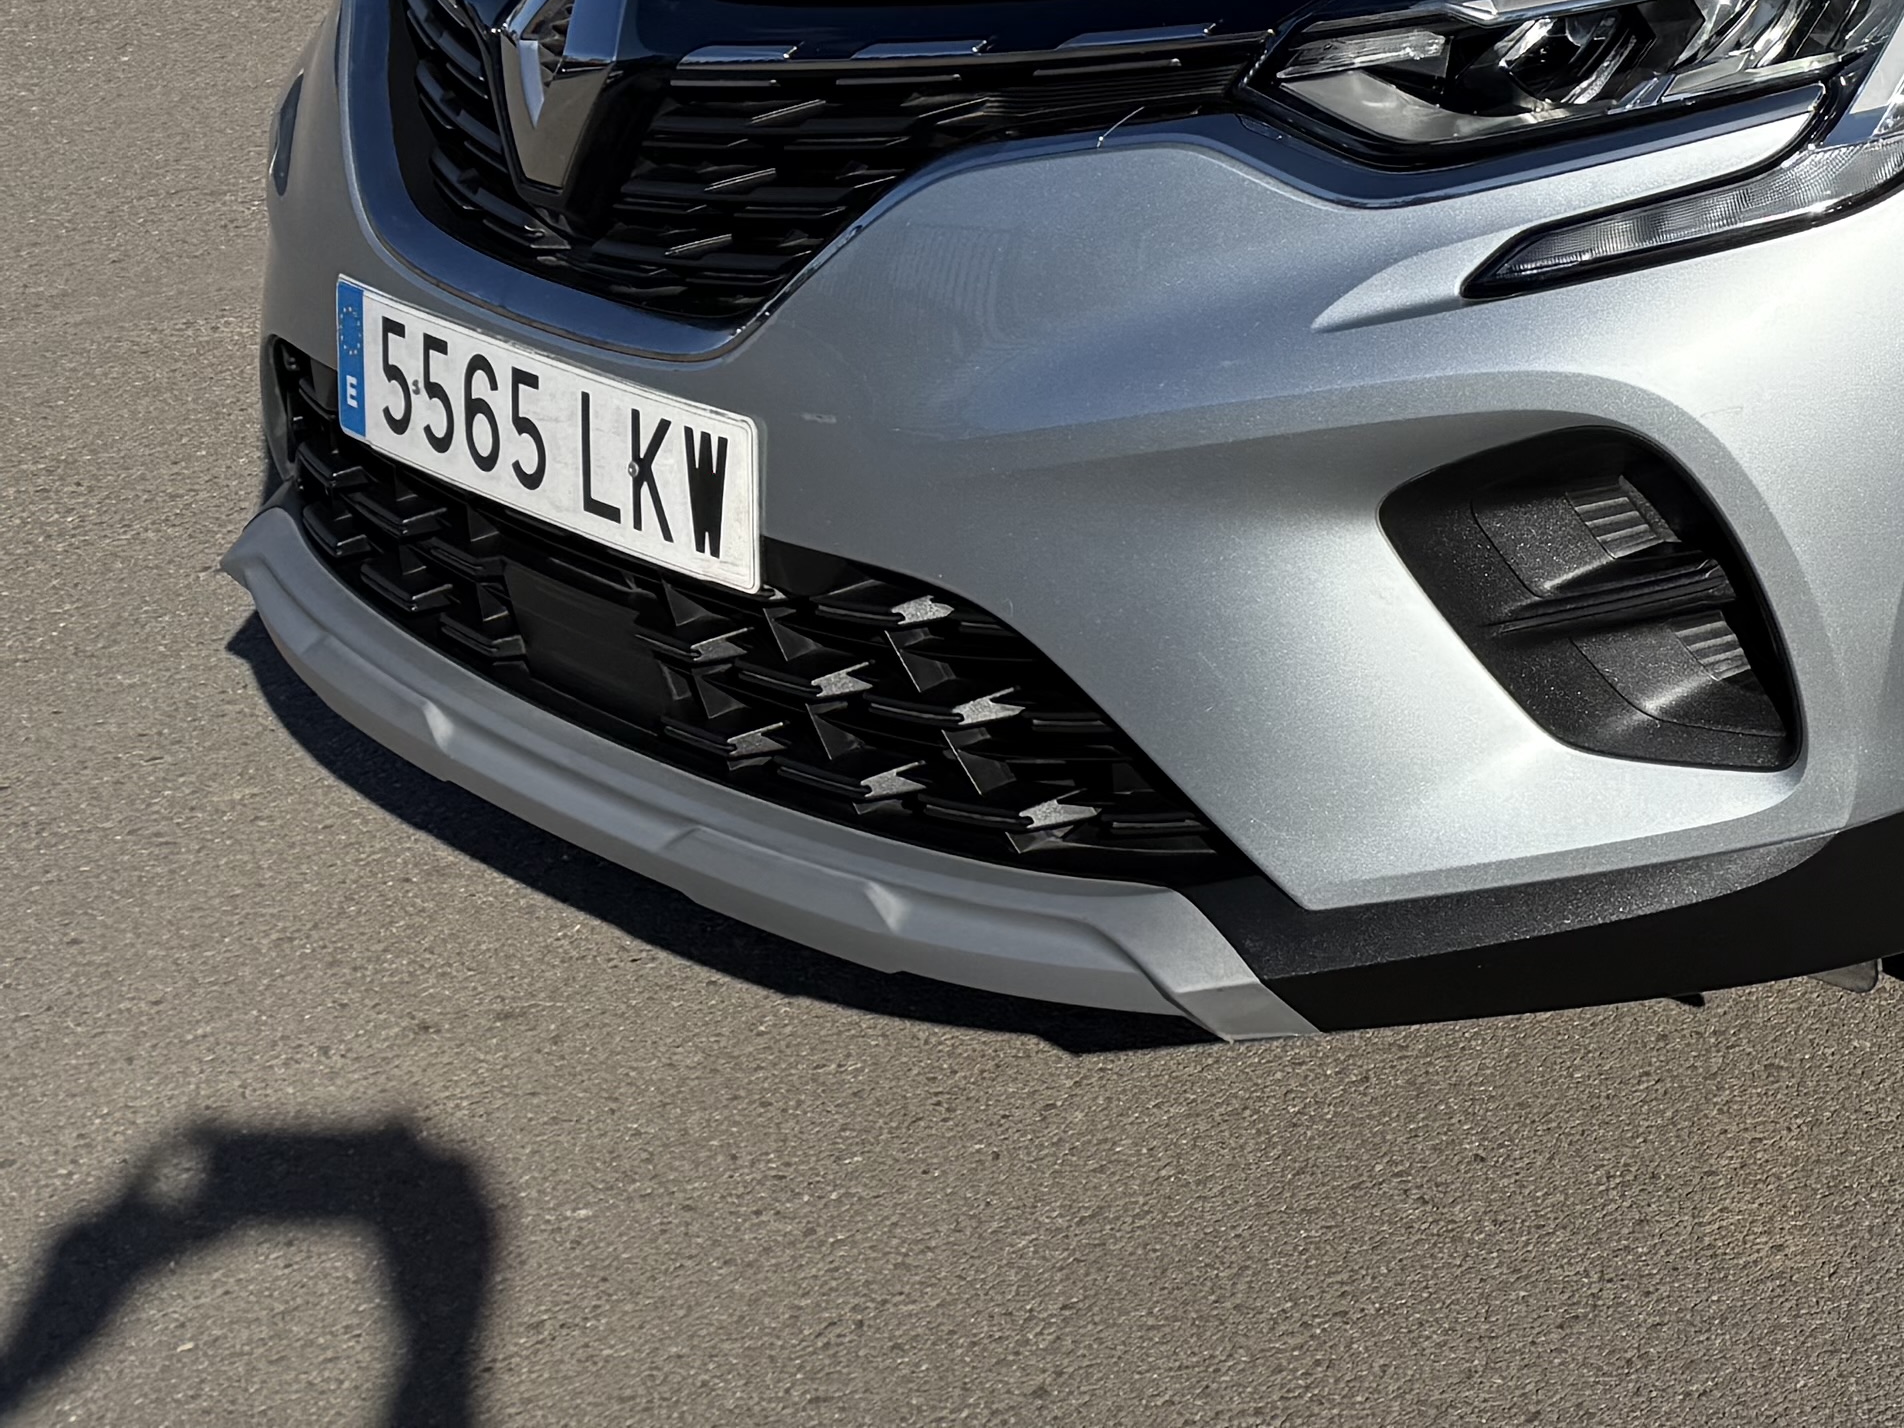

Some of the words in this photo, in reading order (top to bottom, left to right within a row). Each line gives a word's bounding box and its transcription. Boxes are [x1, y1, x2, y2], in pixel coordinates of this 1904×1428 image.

[345, 375, 359, 409] E
[381, 315, 547, 491] 5565
[581, 391, 729, 560] LKW
